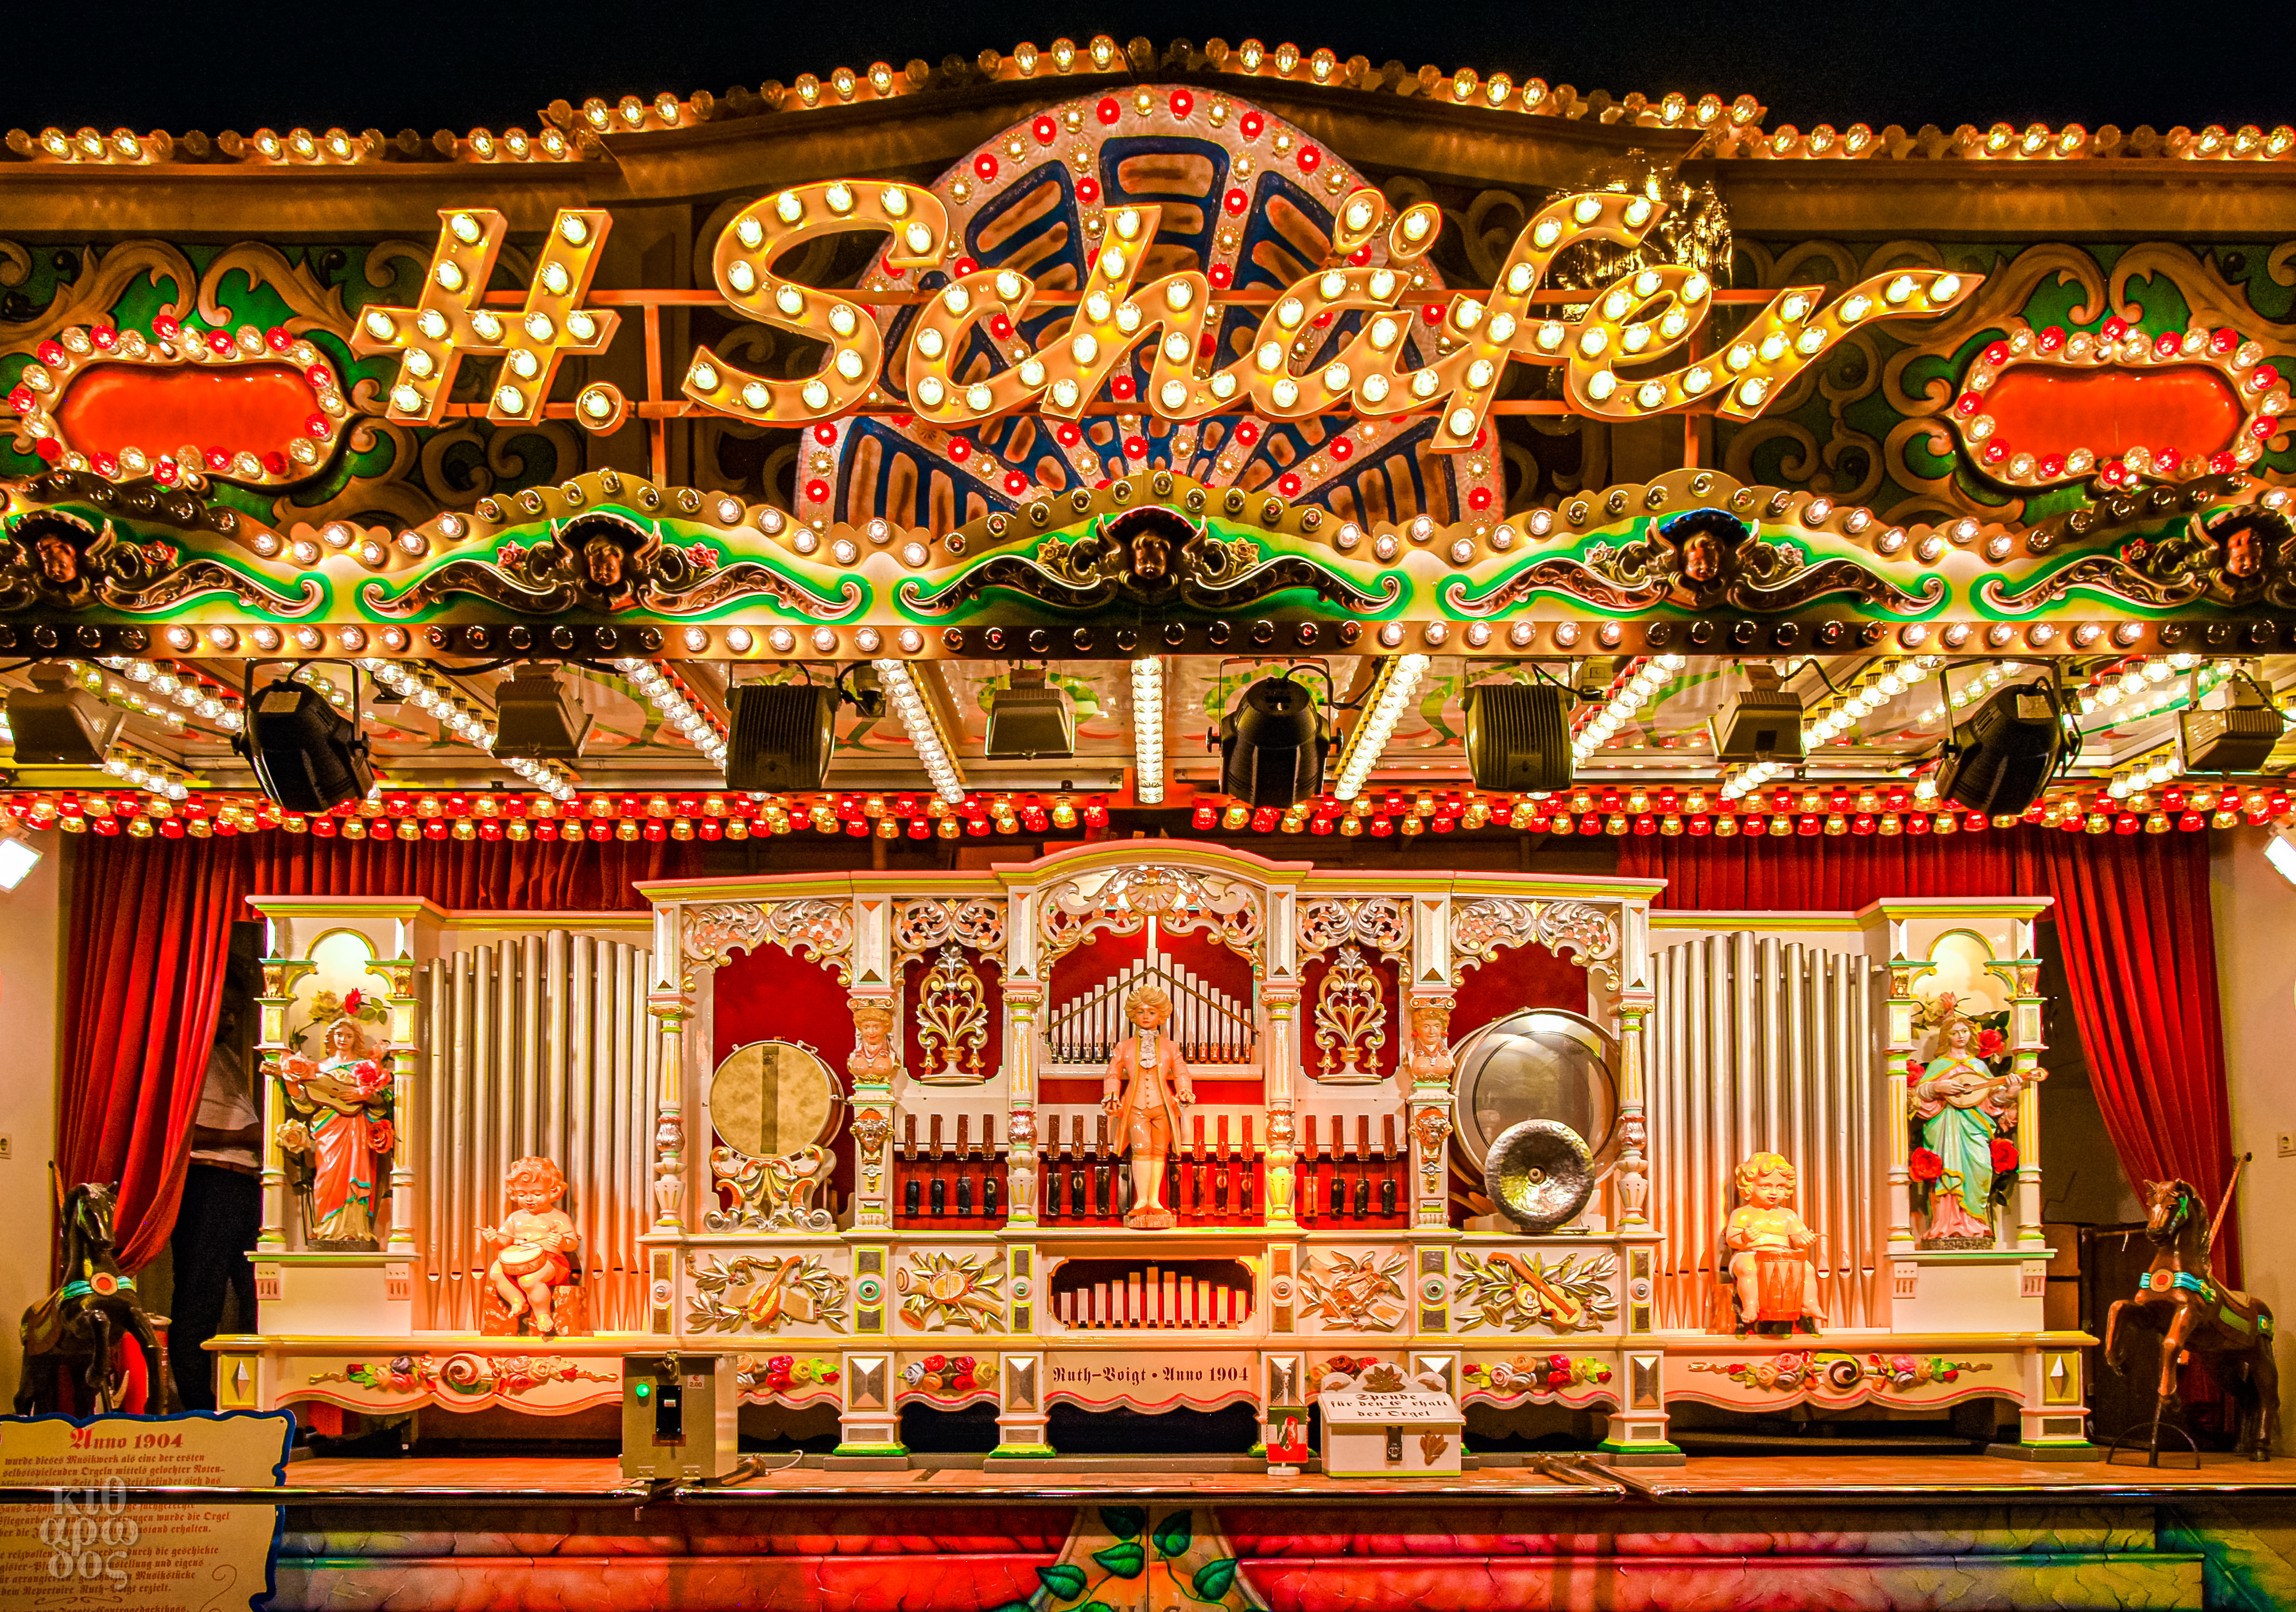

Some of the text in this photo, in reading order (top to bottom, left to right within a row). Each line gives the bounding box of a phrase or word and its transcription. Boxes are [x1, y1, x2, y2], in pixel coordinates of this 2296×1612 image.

[350, 179, 1985, 454] H. Schäfer
[1162, 1367, 1203, 1382] Anno
[1209, 1367, 1249, 1381] 1904
[1355, 1394, 1417, 1402] Spende
[1387, 1410, 1431, 1418] Orgel
[69, 1427, 183, 1450] Anno 1904
[5, 1454, 205, 1465] wurde dieses Musikwerk als eine der ersten
[80, 1467, 113, 1477] Orgeln
[115, 1466, 147, 1475] mittels
[150, 1466, 191, 1477] gelochter
[193, 1464, 225, 1474] Noten-
[184, 1476, 203, 1486] sich
[205, 1476, 222, 1485] das
[157, 1513, 184, 1521] wurde
[187, 1512, 201, 1521] die
[204, 1511, 230, 1522] Orgel
[17, 1528, 29, 1537] die
[171, 1524, 211, 1535] erhalten.
[8, 1549, 54, 1561] reizvollen
[127, 1547, 153, 1557] durch
[155, 1547, 169, 1556] die
[171, 1545, 219, 1557] geschickte
[155, 1558, 172, 1568] und
[174, 1558, 204, 1570] eigens
[135, 1571, 196, 1580] Musikstücke
[1, 1587, 20, 1596] dem
[23, 1585, 74, 1596] Repertoire
[139, 1583, 172, 1595] erzielt.
